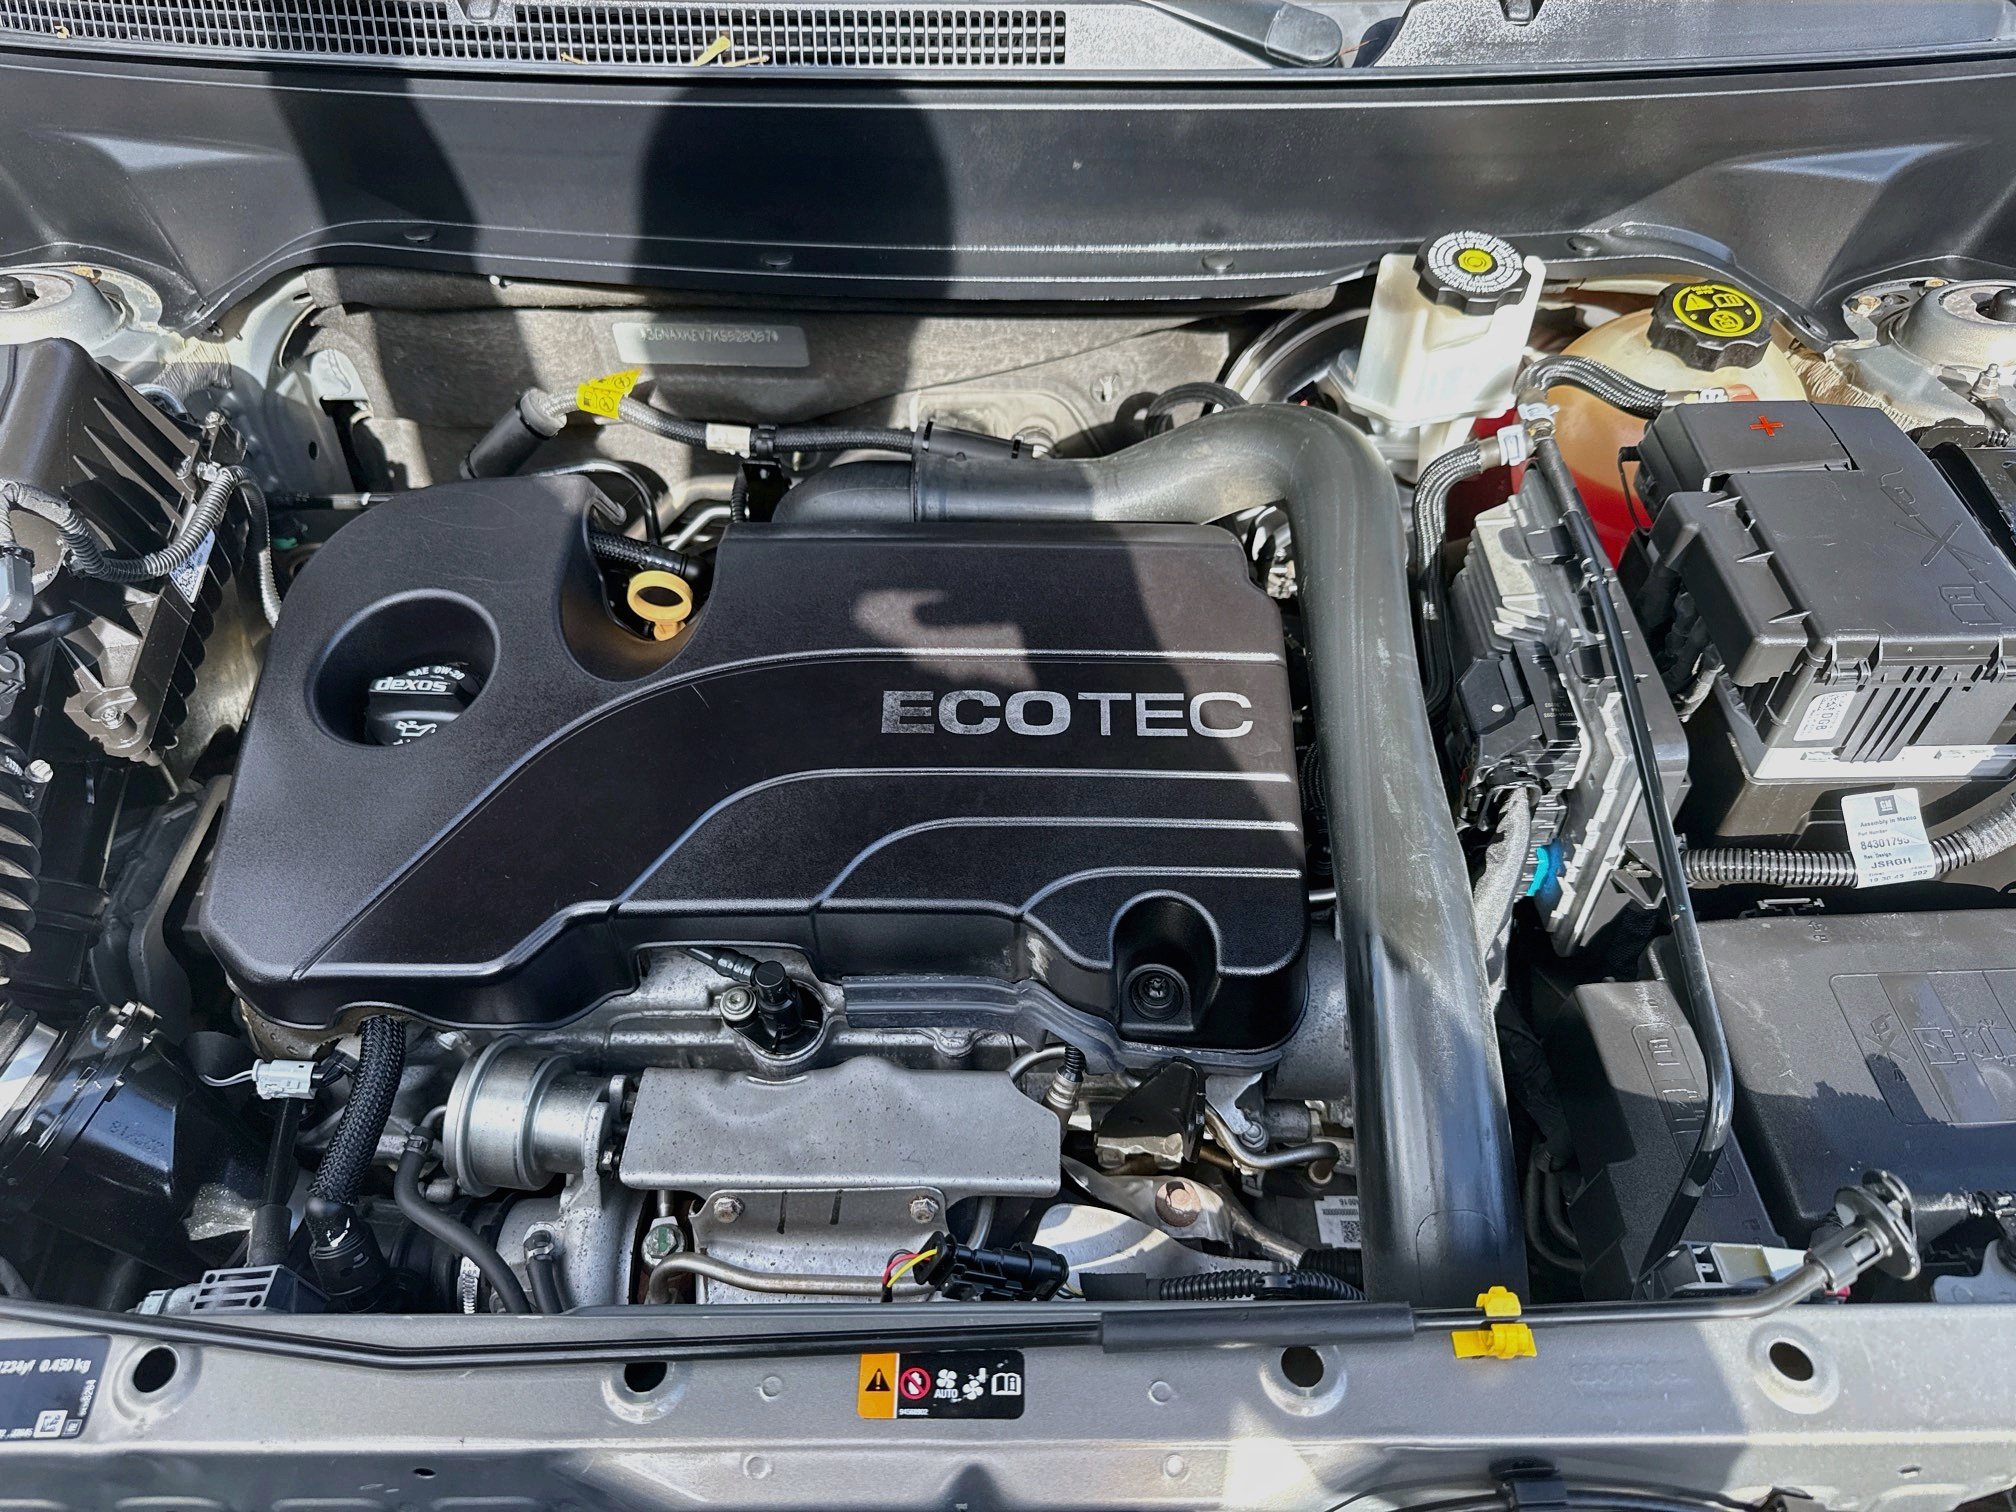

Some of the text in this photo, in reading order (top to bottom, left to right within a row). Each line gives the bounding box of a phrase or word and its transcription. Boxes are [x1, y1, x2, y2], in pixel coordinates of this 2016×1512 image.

[407, 666, 430, 677] SAE
[374, 676, 452, 693] dexos
[881, 690, 1254, 738] ECOTEC
[74, 1357, 92, 1375] kg
[933, 1388, 959, 1399] AUTO
